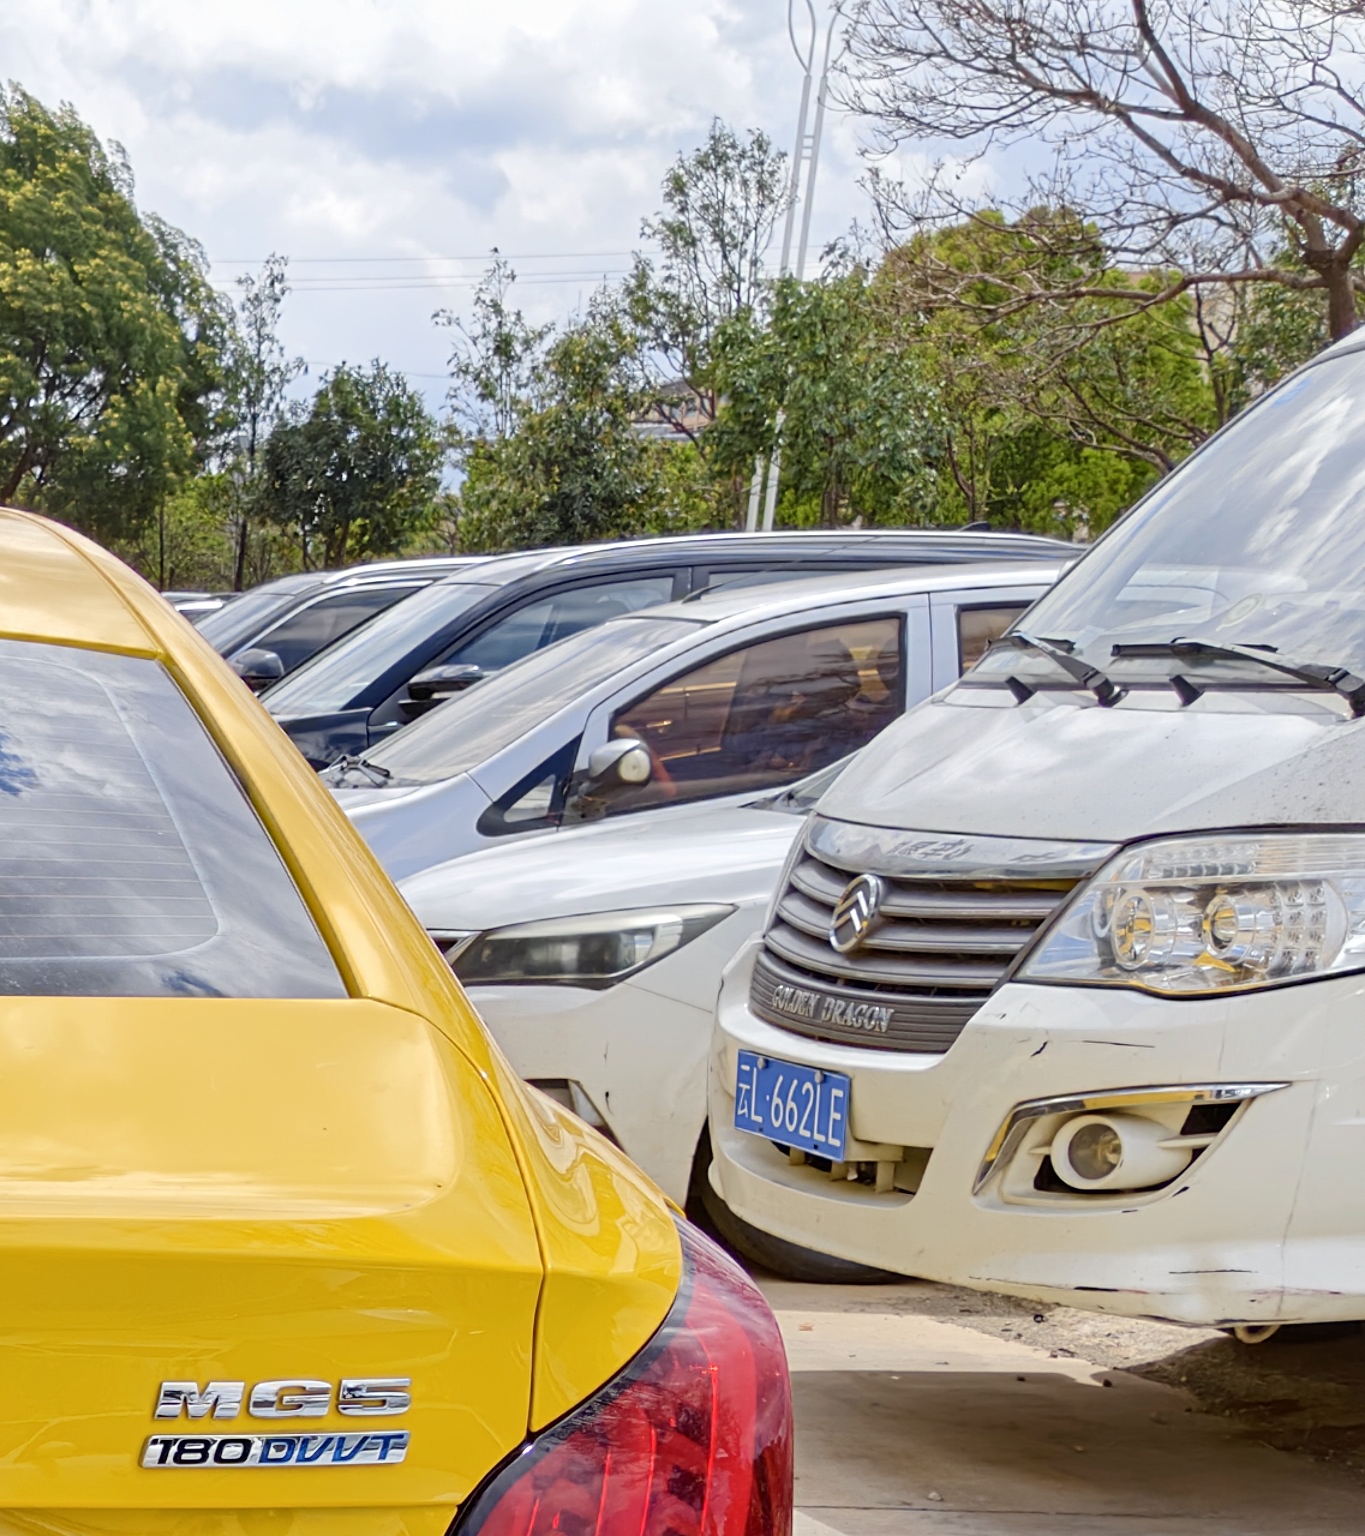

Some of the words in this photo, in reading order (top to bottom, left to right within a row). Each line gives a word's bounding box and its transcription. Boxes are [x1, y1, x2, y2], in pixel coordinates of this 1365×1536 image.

[771, 985, 821, 1018] GOLDEN
[821, 997, 895, 1033] DRAGON
[153, 1378, 412, 1420] MG5
